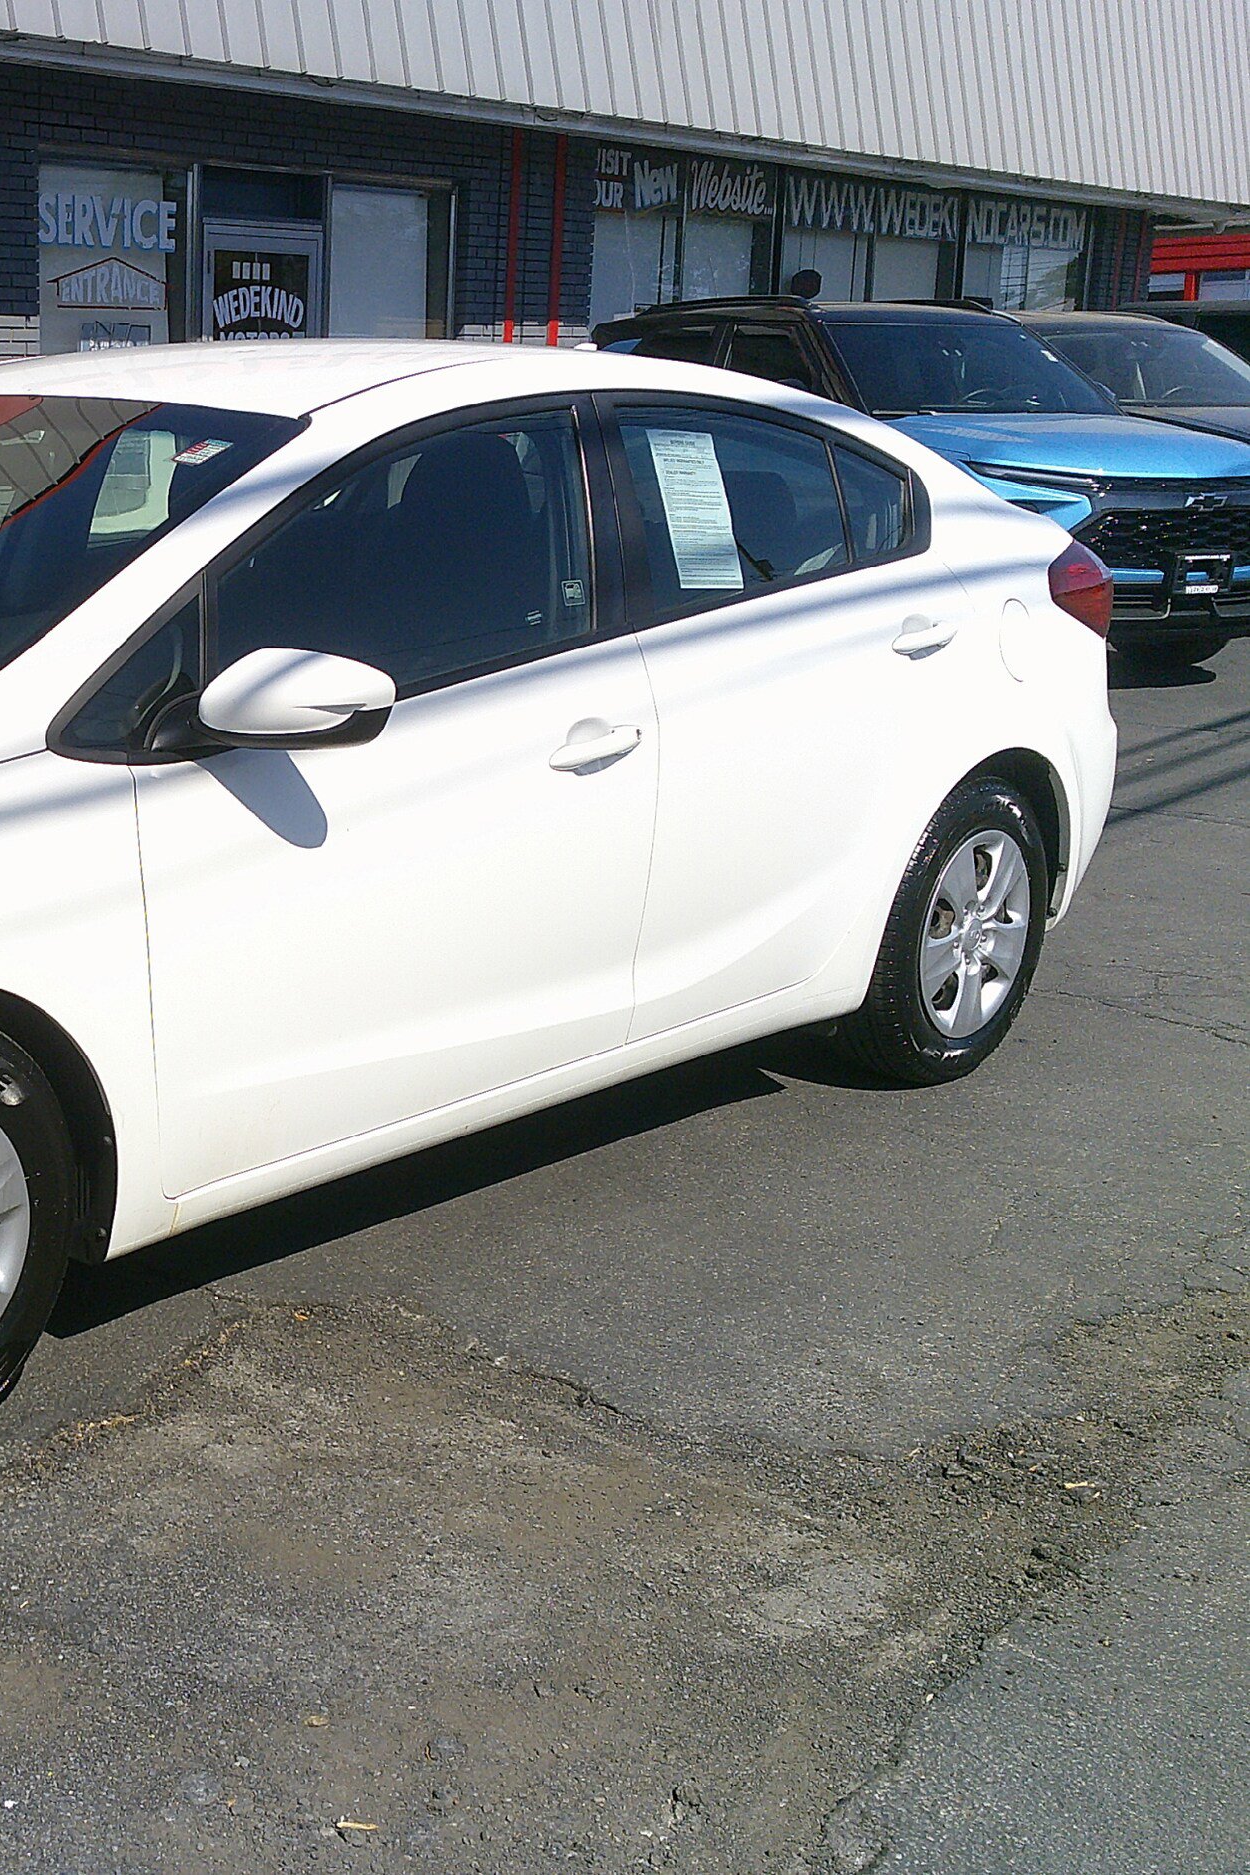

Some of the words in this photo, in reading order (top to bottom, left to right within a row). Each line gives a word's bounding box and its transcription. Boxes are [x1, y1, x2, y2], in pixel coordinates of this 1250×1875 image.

[38, 192, 177, 252] SERVICE
[62, 262, 160, 305] ENTRANCE
[213, 285, 304, 328] WEDEKIND
